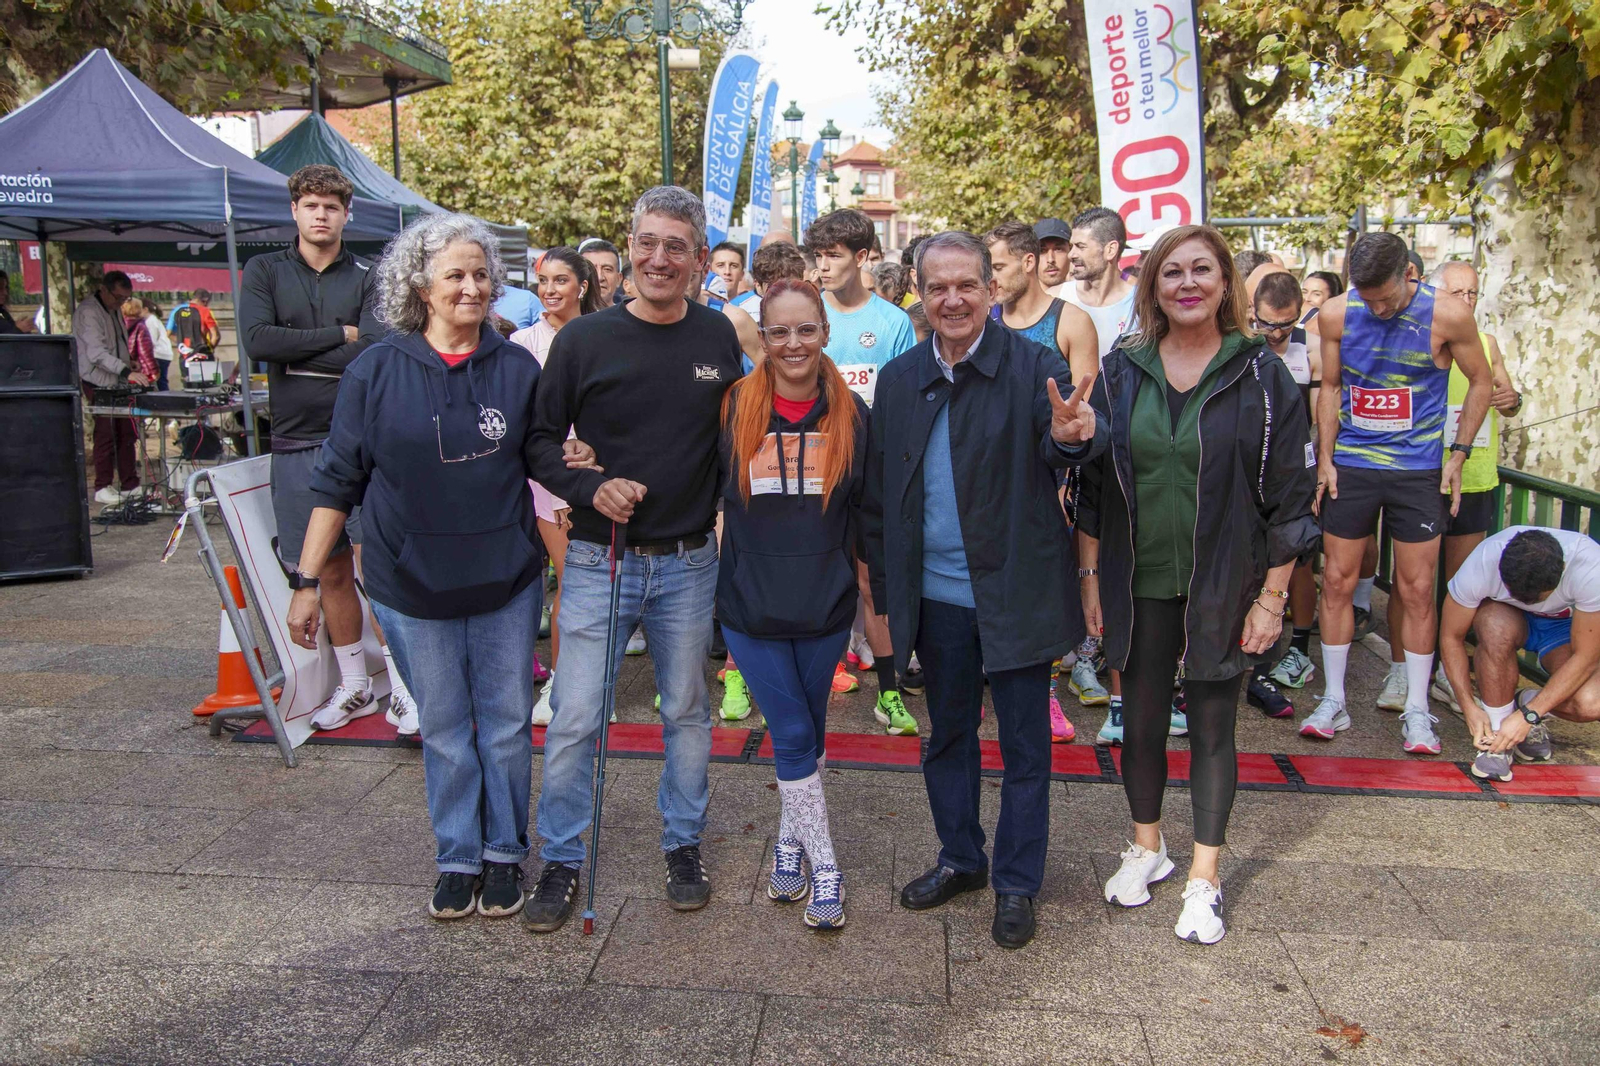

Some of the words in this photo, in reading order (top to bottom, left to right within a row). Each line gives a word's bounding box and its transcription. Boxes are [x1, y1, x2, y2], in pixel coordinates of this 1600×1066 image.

[1133, 8, 1153, 70] mellor
[1102, 14, 1134, 125] deporte
[1139, 72, 1155, 104] teu
[724, 80, 751, 159] GALICIA
[1143, 108, 1155, 120] o
[708, 113, 728, 186] XUNTA
[0, 174, 52, 188] tación
[719, 166, 736, 193] DE
[0, 189, 53, 203] evedra
[1112, 135, 1192, 270] GO
[839, 370, 869, 386] 28
[1364, 394, 1400, 409] 223
[1262, 425, 1271, 460] PRIVATE
